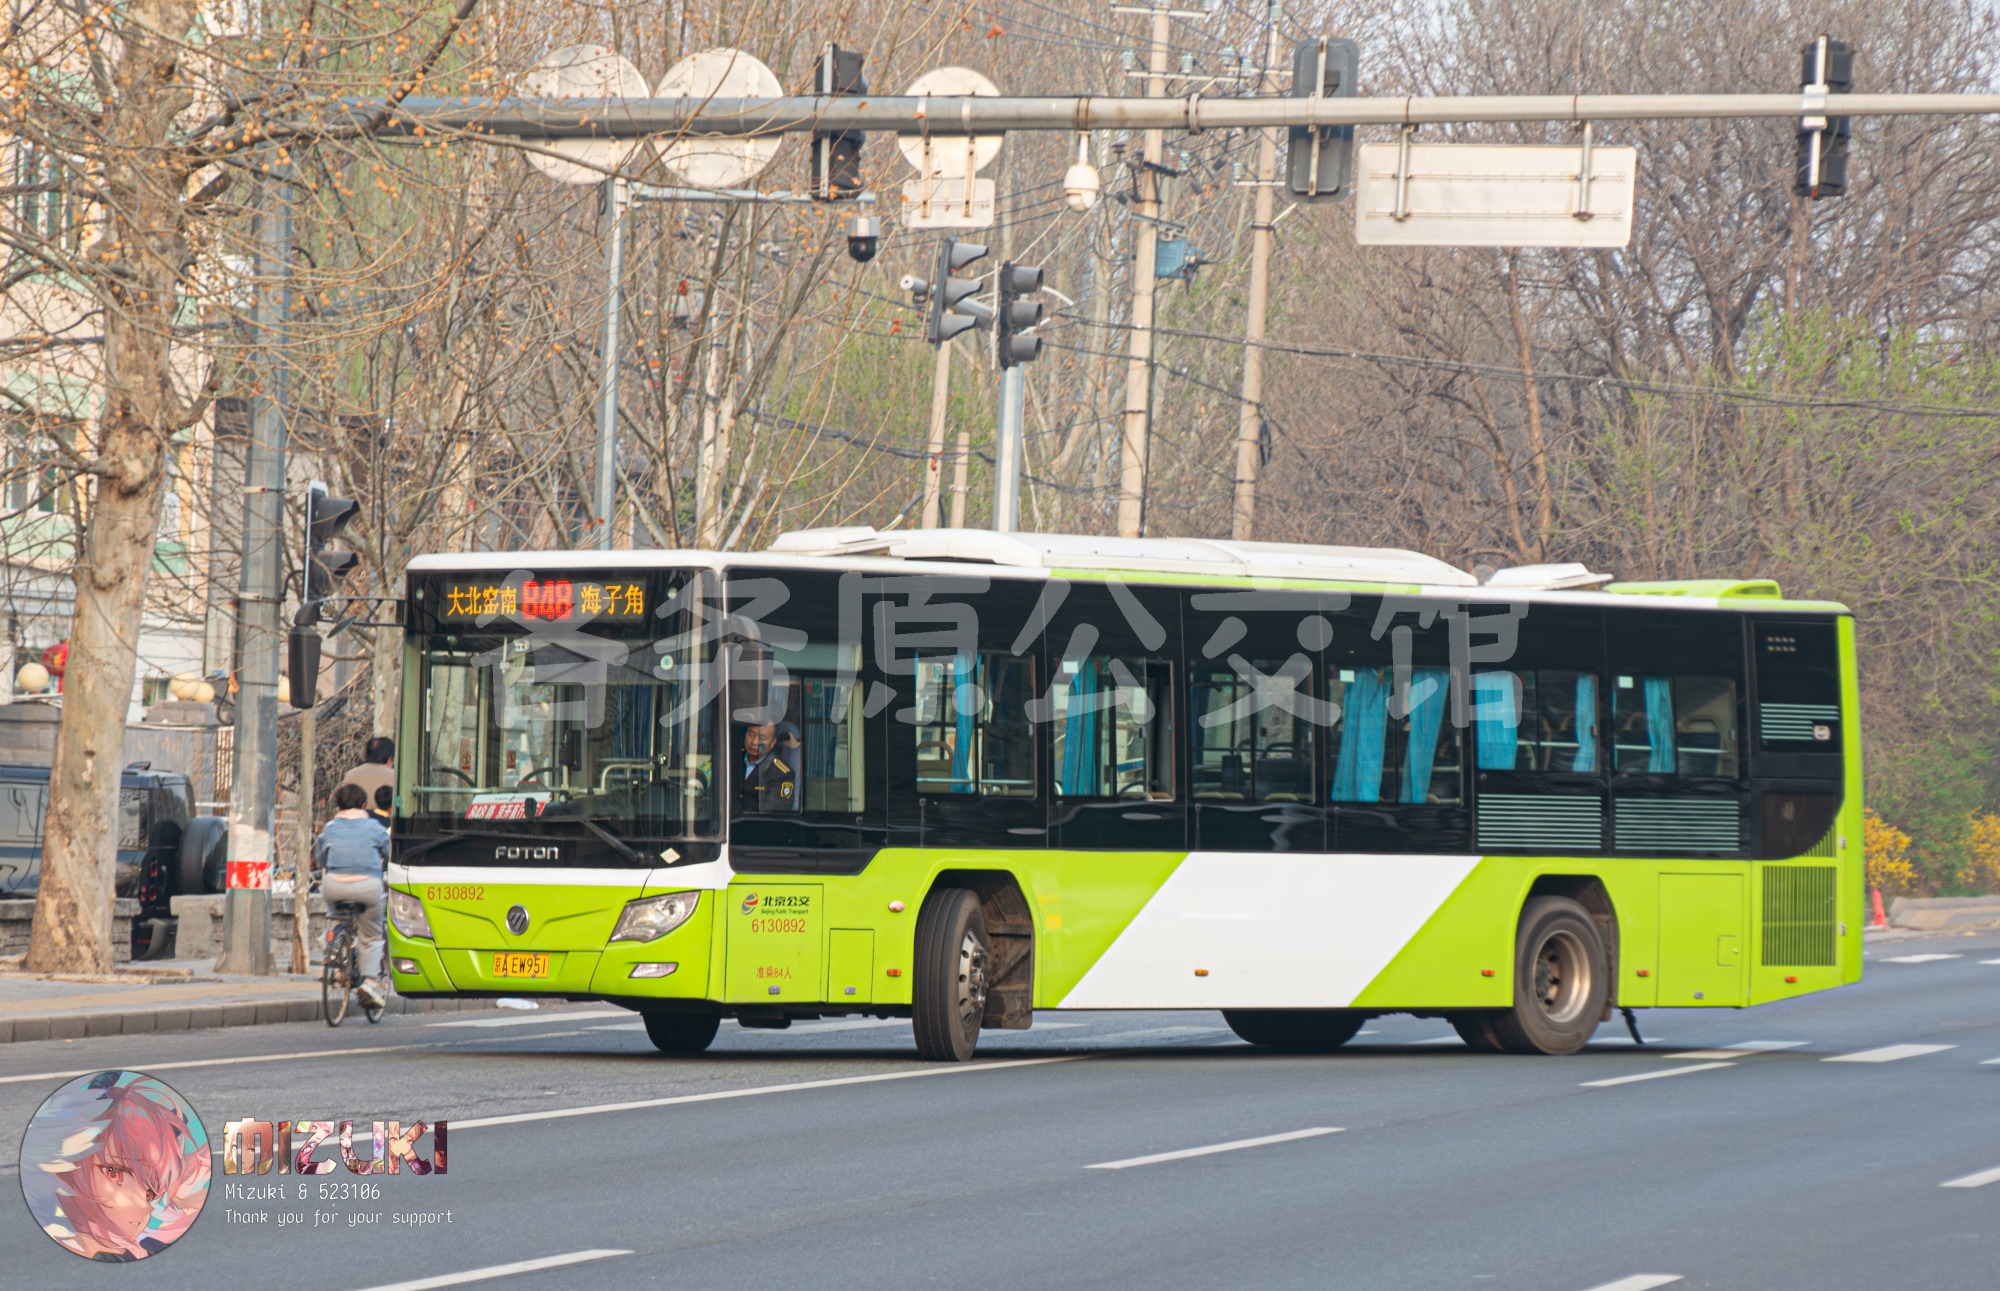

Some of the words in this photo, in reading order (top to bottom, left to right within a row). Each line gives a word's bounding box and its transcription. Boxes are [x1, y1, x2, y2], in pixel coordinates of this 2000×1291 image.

[447, 585, 517, 617] 大北窑南
[522, 580, 573, 620] 848
[581, 584, 645, 616] 海子角
[495, 846, 559, 860] FOTON
[427, 886, 485, 901] 6130892
[762, 896, 809, 906] 北京公交
[751, 918, 806, 933] 6130892
